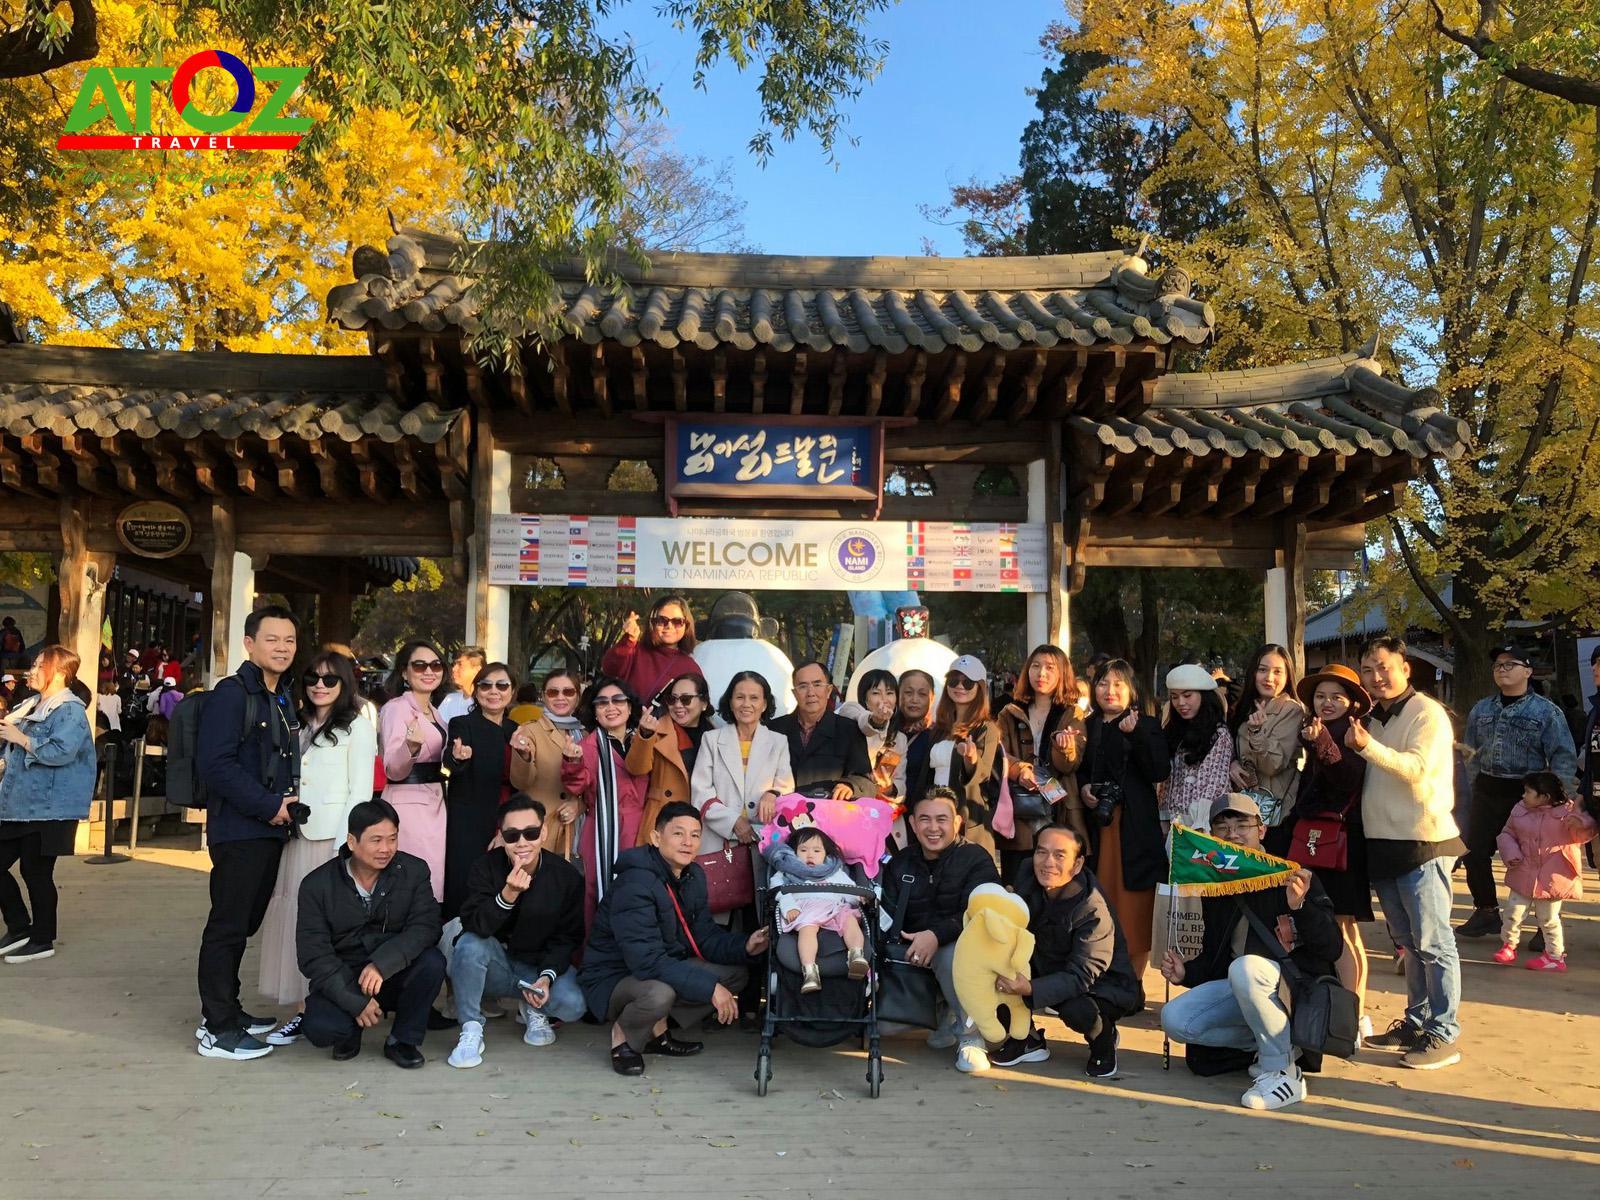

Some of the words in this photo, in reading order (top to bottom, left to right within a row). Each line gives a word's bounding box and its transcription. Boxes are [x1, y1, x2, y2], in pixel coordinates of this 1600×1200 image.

[662, 541, 818, 567] WELCOME
[844, 556, 869, 565] NAMI
[664, 568, 679, 580] TO
[682, 568, 756, 581] NAMINARA
[759, 569, 818, 582] REPUBLIC
